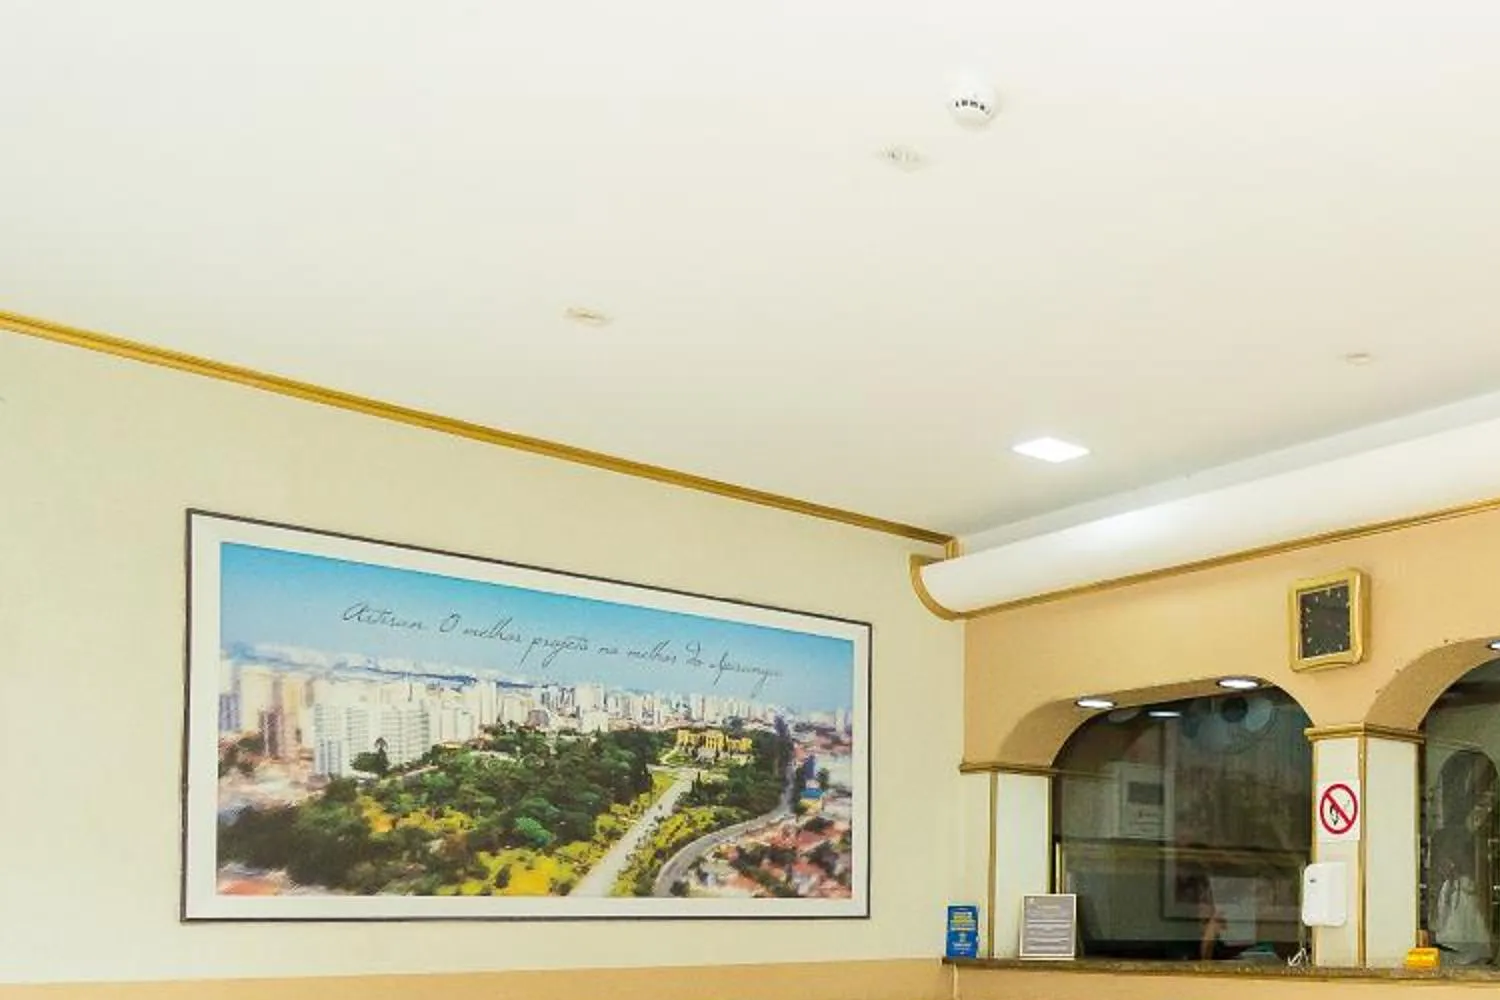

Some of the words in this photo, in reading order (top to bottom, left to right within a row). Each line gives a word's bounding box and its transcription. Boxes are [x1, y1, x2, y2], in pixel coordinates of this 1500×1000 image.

[439, 609, 461, 633] O
[463, 616, 521, 643] melhor
[626, 639, 677, 665] melhor
